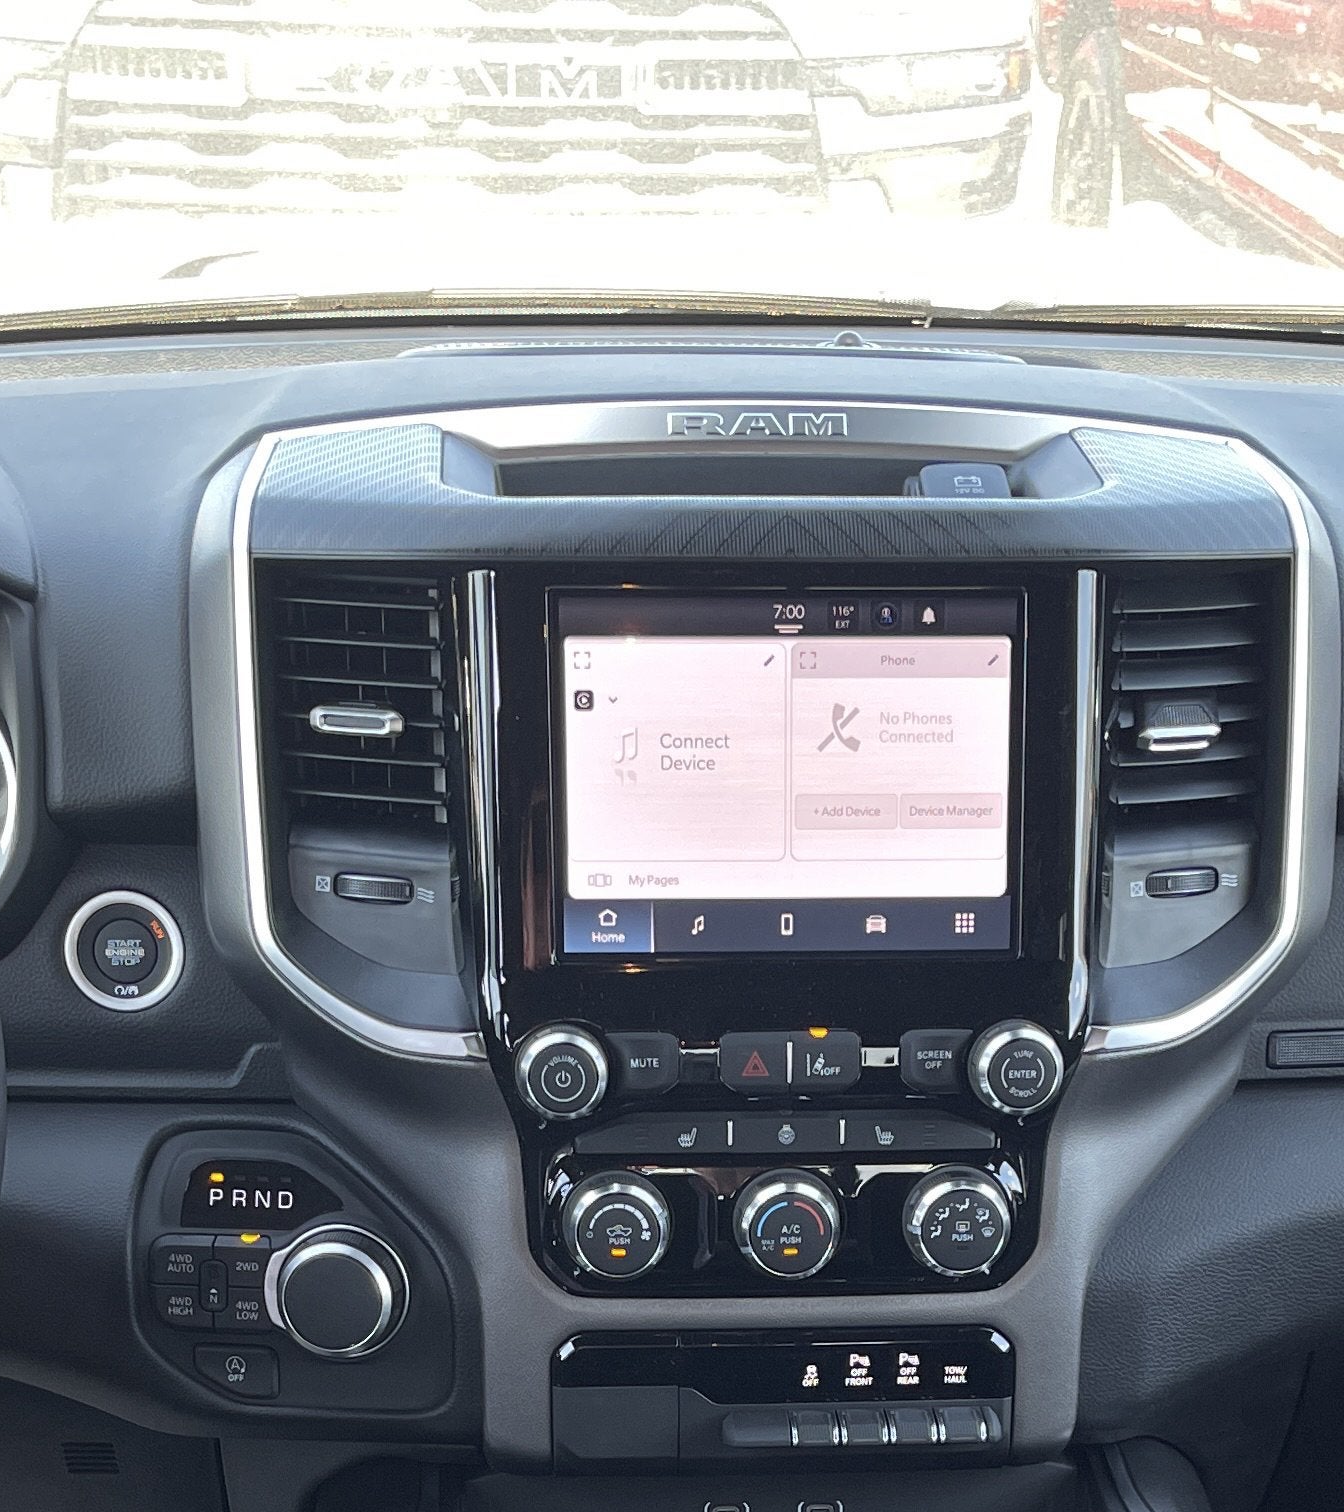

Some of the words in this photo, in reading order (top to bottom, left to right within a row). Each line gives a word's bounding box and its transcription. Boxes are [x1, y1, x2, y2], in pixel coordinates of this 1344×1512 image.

[667, 412, 848, 436] RAM
[773, 604, 805, 619] 7:00
[832, 606, 855, 617] 116°
[835, 620, 850, 629] EXT
[880, 655, 916, 667] Phone
[879, 712, 899, 726] No
[904, 712, 953, 726] Phones
[660, 733, 730, 750] Connect
[879, 730, 954, 744] Connected
[660, 756, 716, 772] Device
[822, 806, 844, 817] Add
[846, 806, 881, 817] Device
[909, 806, 942, 817] Device
[944, 806, 993, 819] Manager
[628, 875, 646, 889] My
[648, 875, 679, 889] Pages
[592, 932, 625, 943] Home
[111, 957, 141, 965] STOP
[916, 1050, 952, 1060] SCREEN
[1013, 1050, 1034, 1059] TUNE
[548, 1055, 578, 1066] VOLUME
[630, 1058, 660, 1068] MUTE
[924, 1061, 943, 1069] OFF
[824, 1066, 841, 1076] OFF
[1008, 1070, 1037, 1079] ENTER
[1008, 1086, 1038, 1098] SCROLL
[210, 1189, 223, 1206] P
[232, 1189, 246, 1207] R
[255, 1190, 271, 1208] N
[278, 1191, 293, 1209] D
[781, 1225, 801, 1234] A/C
[951, 1233, 974, 1241] PUSH
[169, 1253, 193, 1263] 4WD
[167, 1263, 194, 1273] AUTO
[235, 1262, 259, 1271] 2WD
[169, 1296, 193, 1306] 4WD
[209, 1294, 218, 1304] N
[168, 1306, 194, 1315] HIGH
[235, 1301, 259, 1311] 4WD
[236, 1311, 259, 1320] LOW
[850, 1368, 867, 1377] OFF
[900, 1367, 917, 1376] OFF
[944, 1366, 967, 1375] TOW/
[227, 1374, 244, 1382] OFF
[802, 1378, 819, 1387] OFF
[845, 1377, 873, 1387] FRONT
[897, 1376, 920, 1385] REAR
[944, 1375, 967, 1384] HAUL
